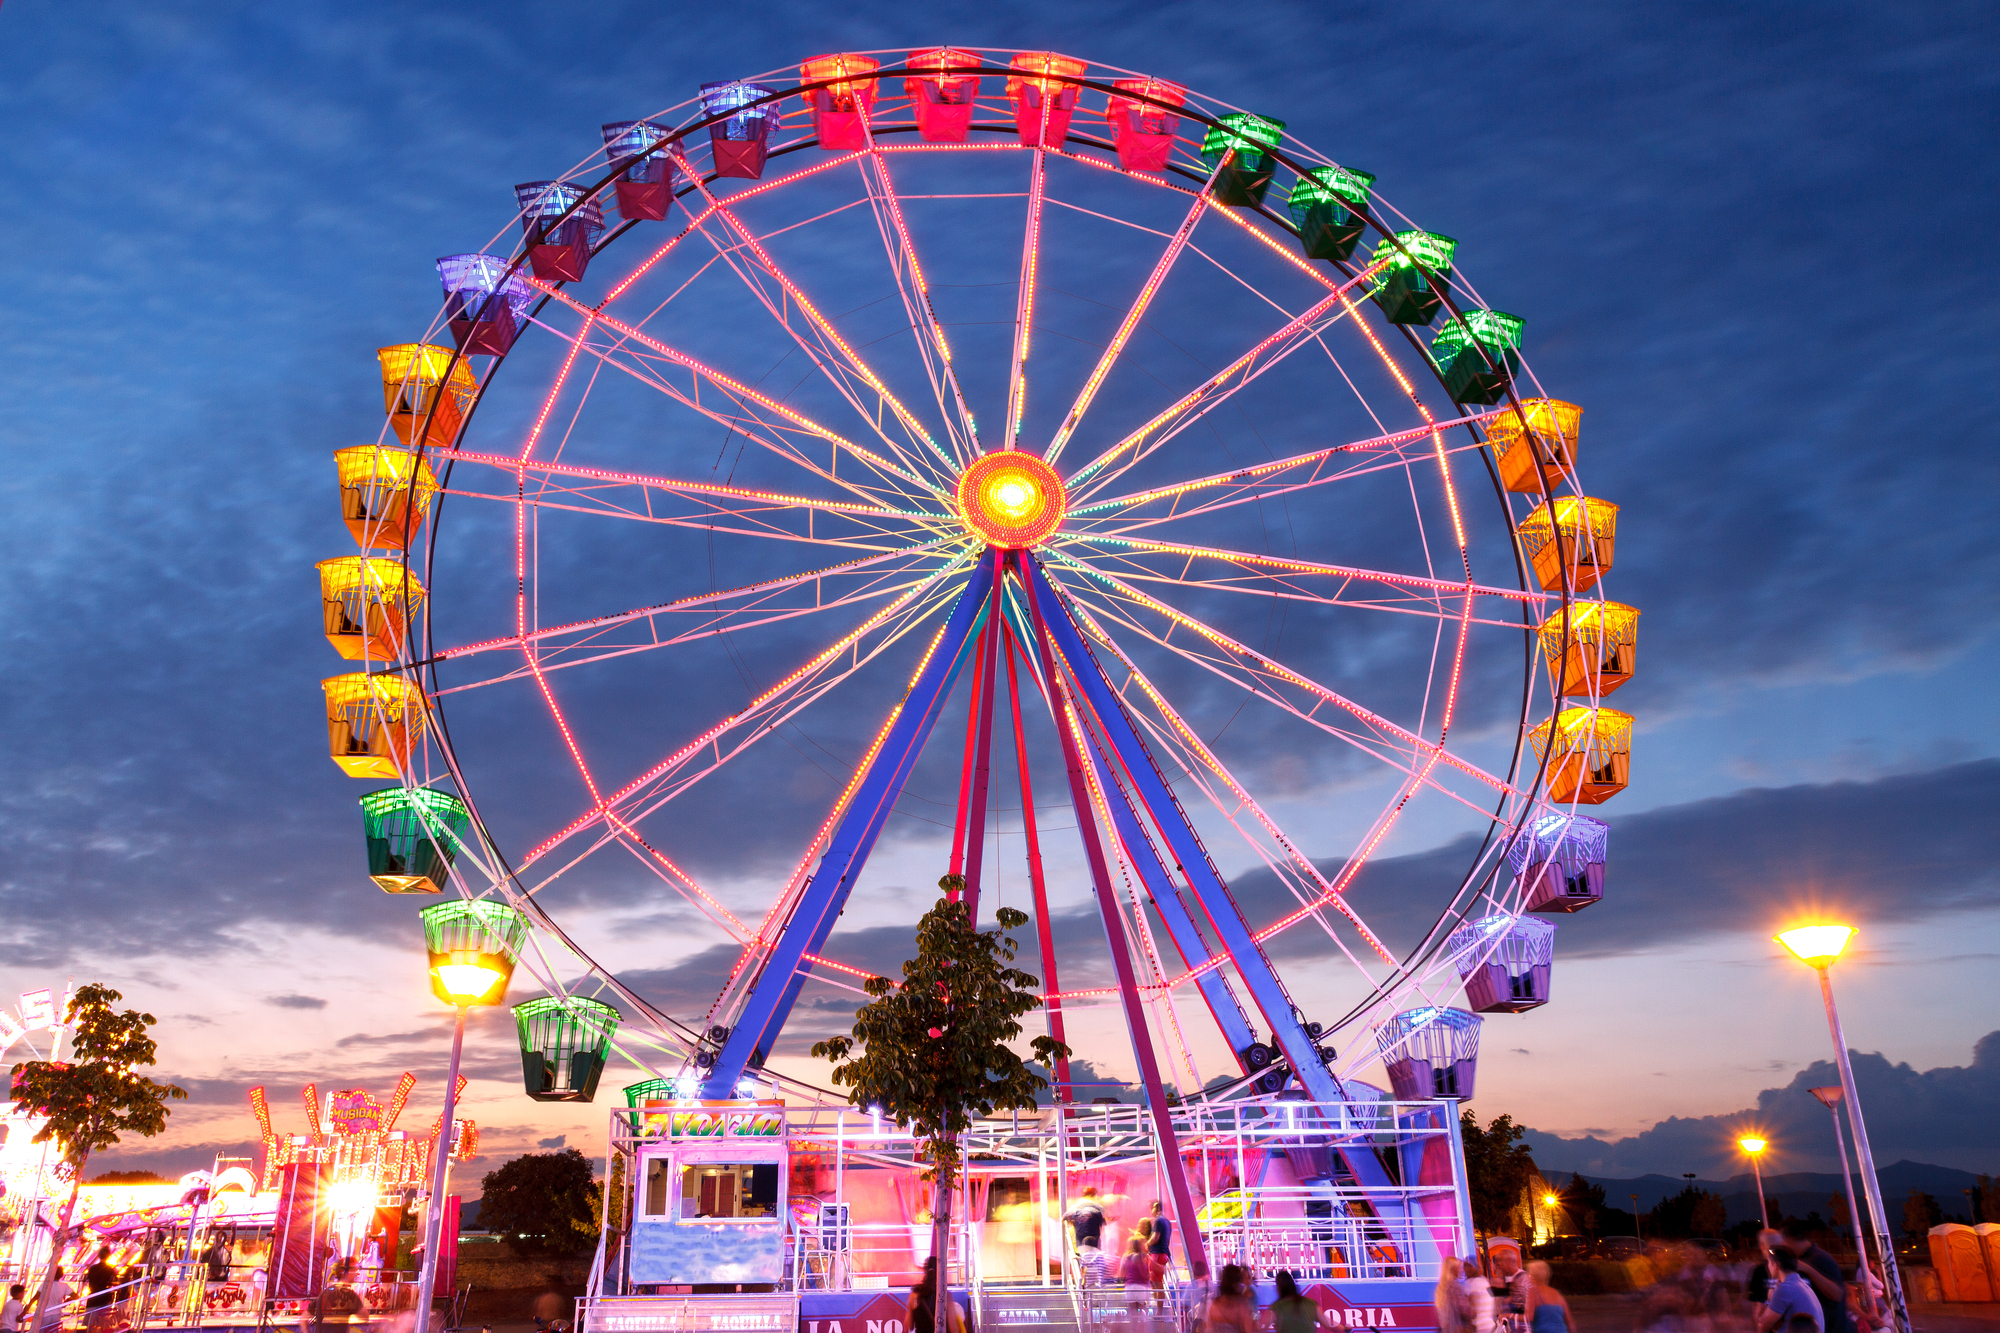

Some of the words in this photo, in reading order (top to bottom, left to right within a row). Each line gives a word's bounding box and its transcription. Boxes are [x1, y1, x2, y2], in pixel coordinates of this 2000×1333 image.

[334, 1107, 378, 1121] MUSIDAN
[606, 1316, 676, 1330] TAQUILLA
[711, 1315, 781, 1329] TAQUILLA
[998, 1310, 1048, 1323] SALIDA
[1314, 1308, 1396, 1327] ORIA
